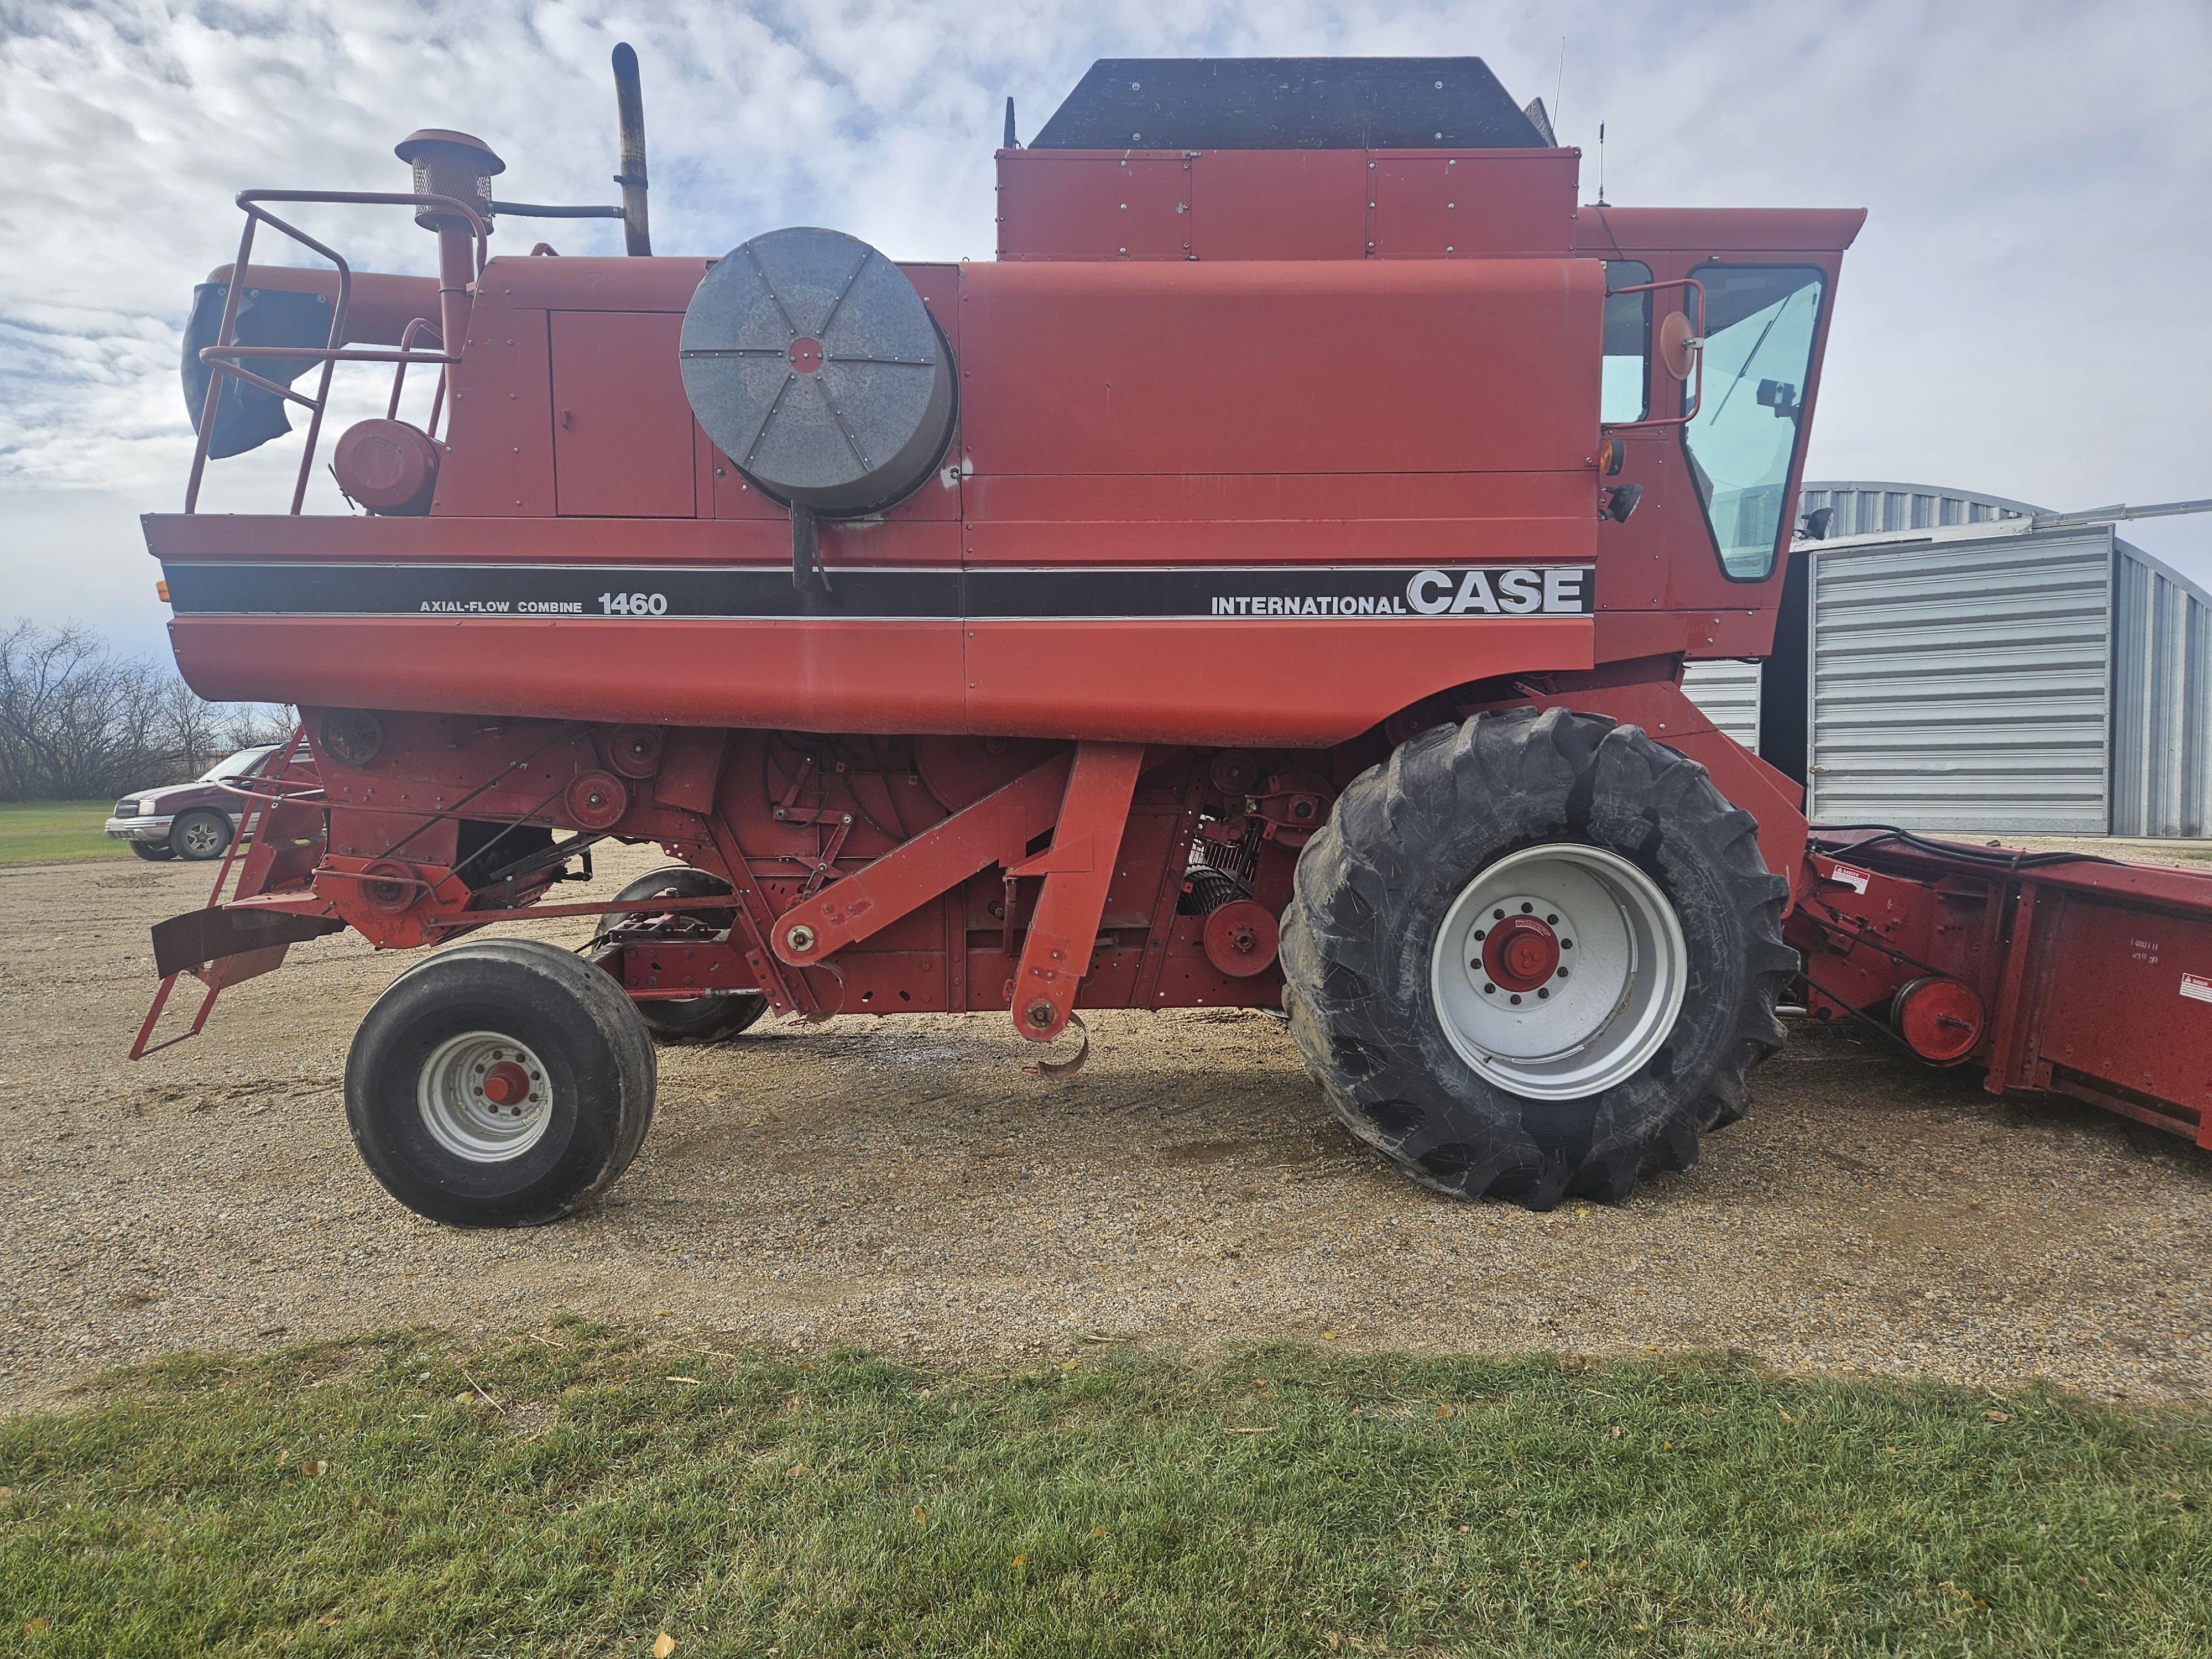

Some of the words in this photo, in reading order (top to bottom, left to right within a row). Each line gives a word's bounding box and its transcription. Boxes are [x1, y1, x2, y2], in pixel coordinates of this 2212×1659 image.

[420, 601, 510, 612] AXIAL-FLOW
[517, 601, 582, 613] COMBINE
[598, 592, 667, 615] 1460
[1212, 596, 1406, 614] INTERNATIONAL
[1406, 570, 1583, 614] CASE
[1843, 869, 1860, 877] DANGER
